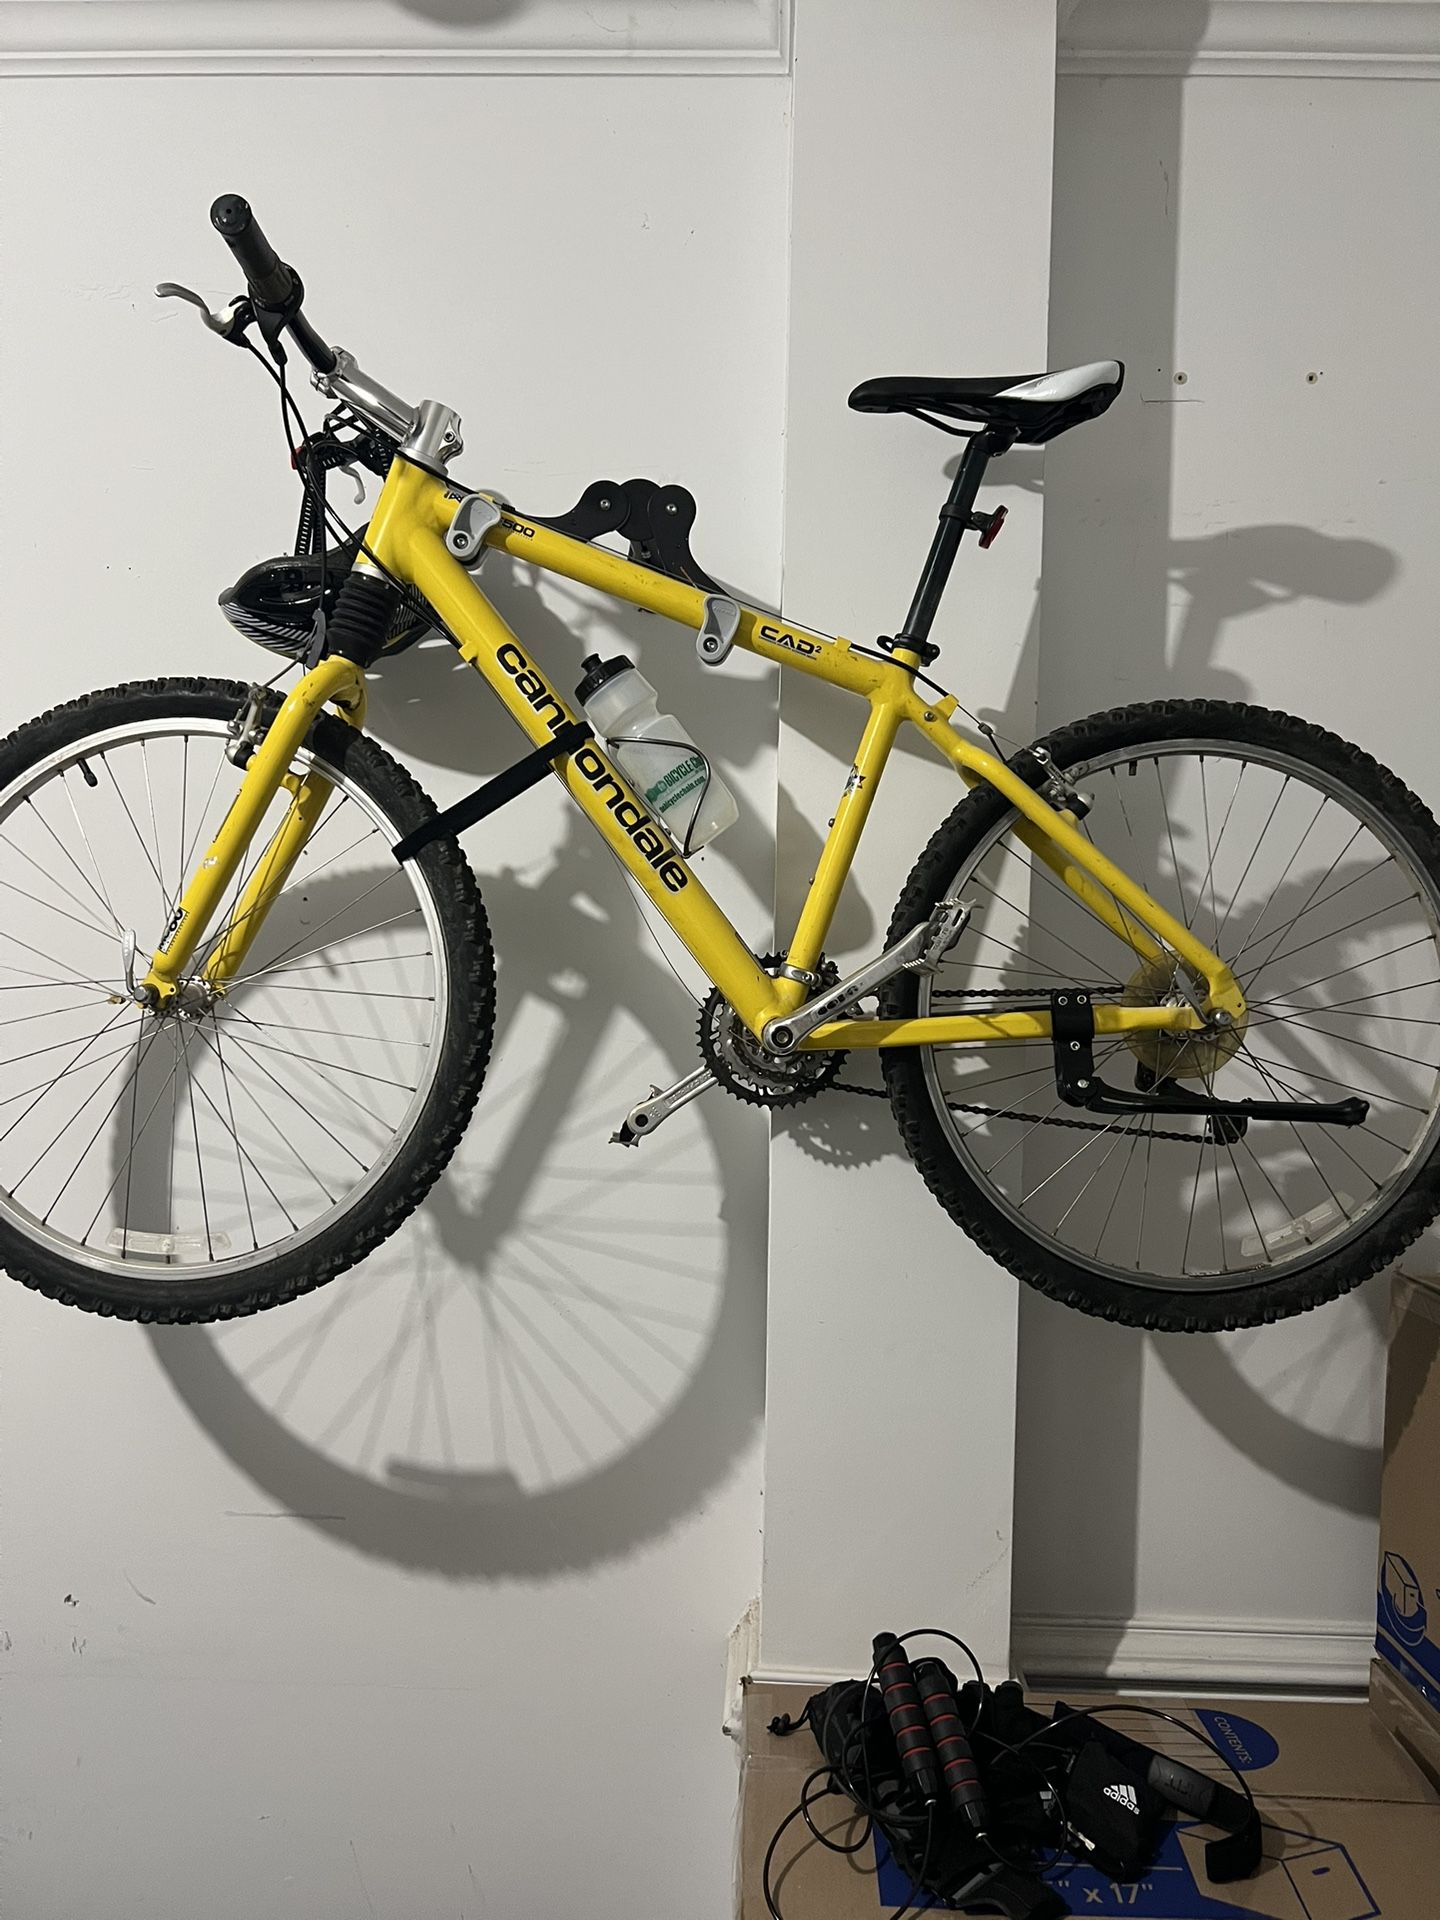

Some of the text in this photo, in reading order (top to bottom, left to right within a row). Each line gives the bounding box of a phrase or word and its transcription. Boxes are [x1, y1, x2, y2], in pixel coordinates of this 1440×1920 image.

[501, 517, 535, 537] 500
[496, 643, 688, 892] canondale
[664, 760, 693, 787] BICYCLE
[1103, 1787, 1140, 1815] adidas
[1110, 1882, 1153, 1904] 17"
